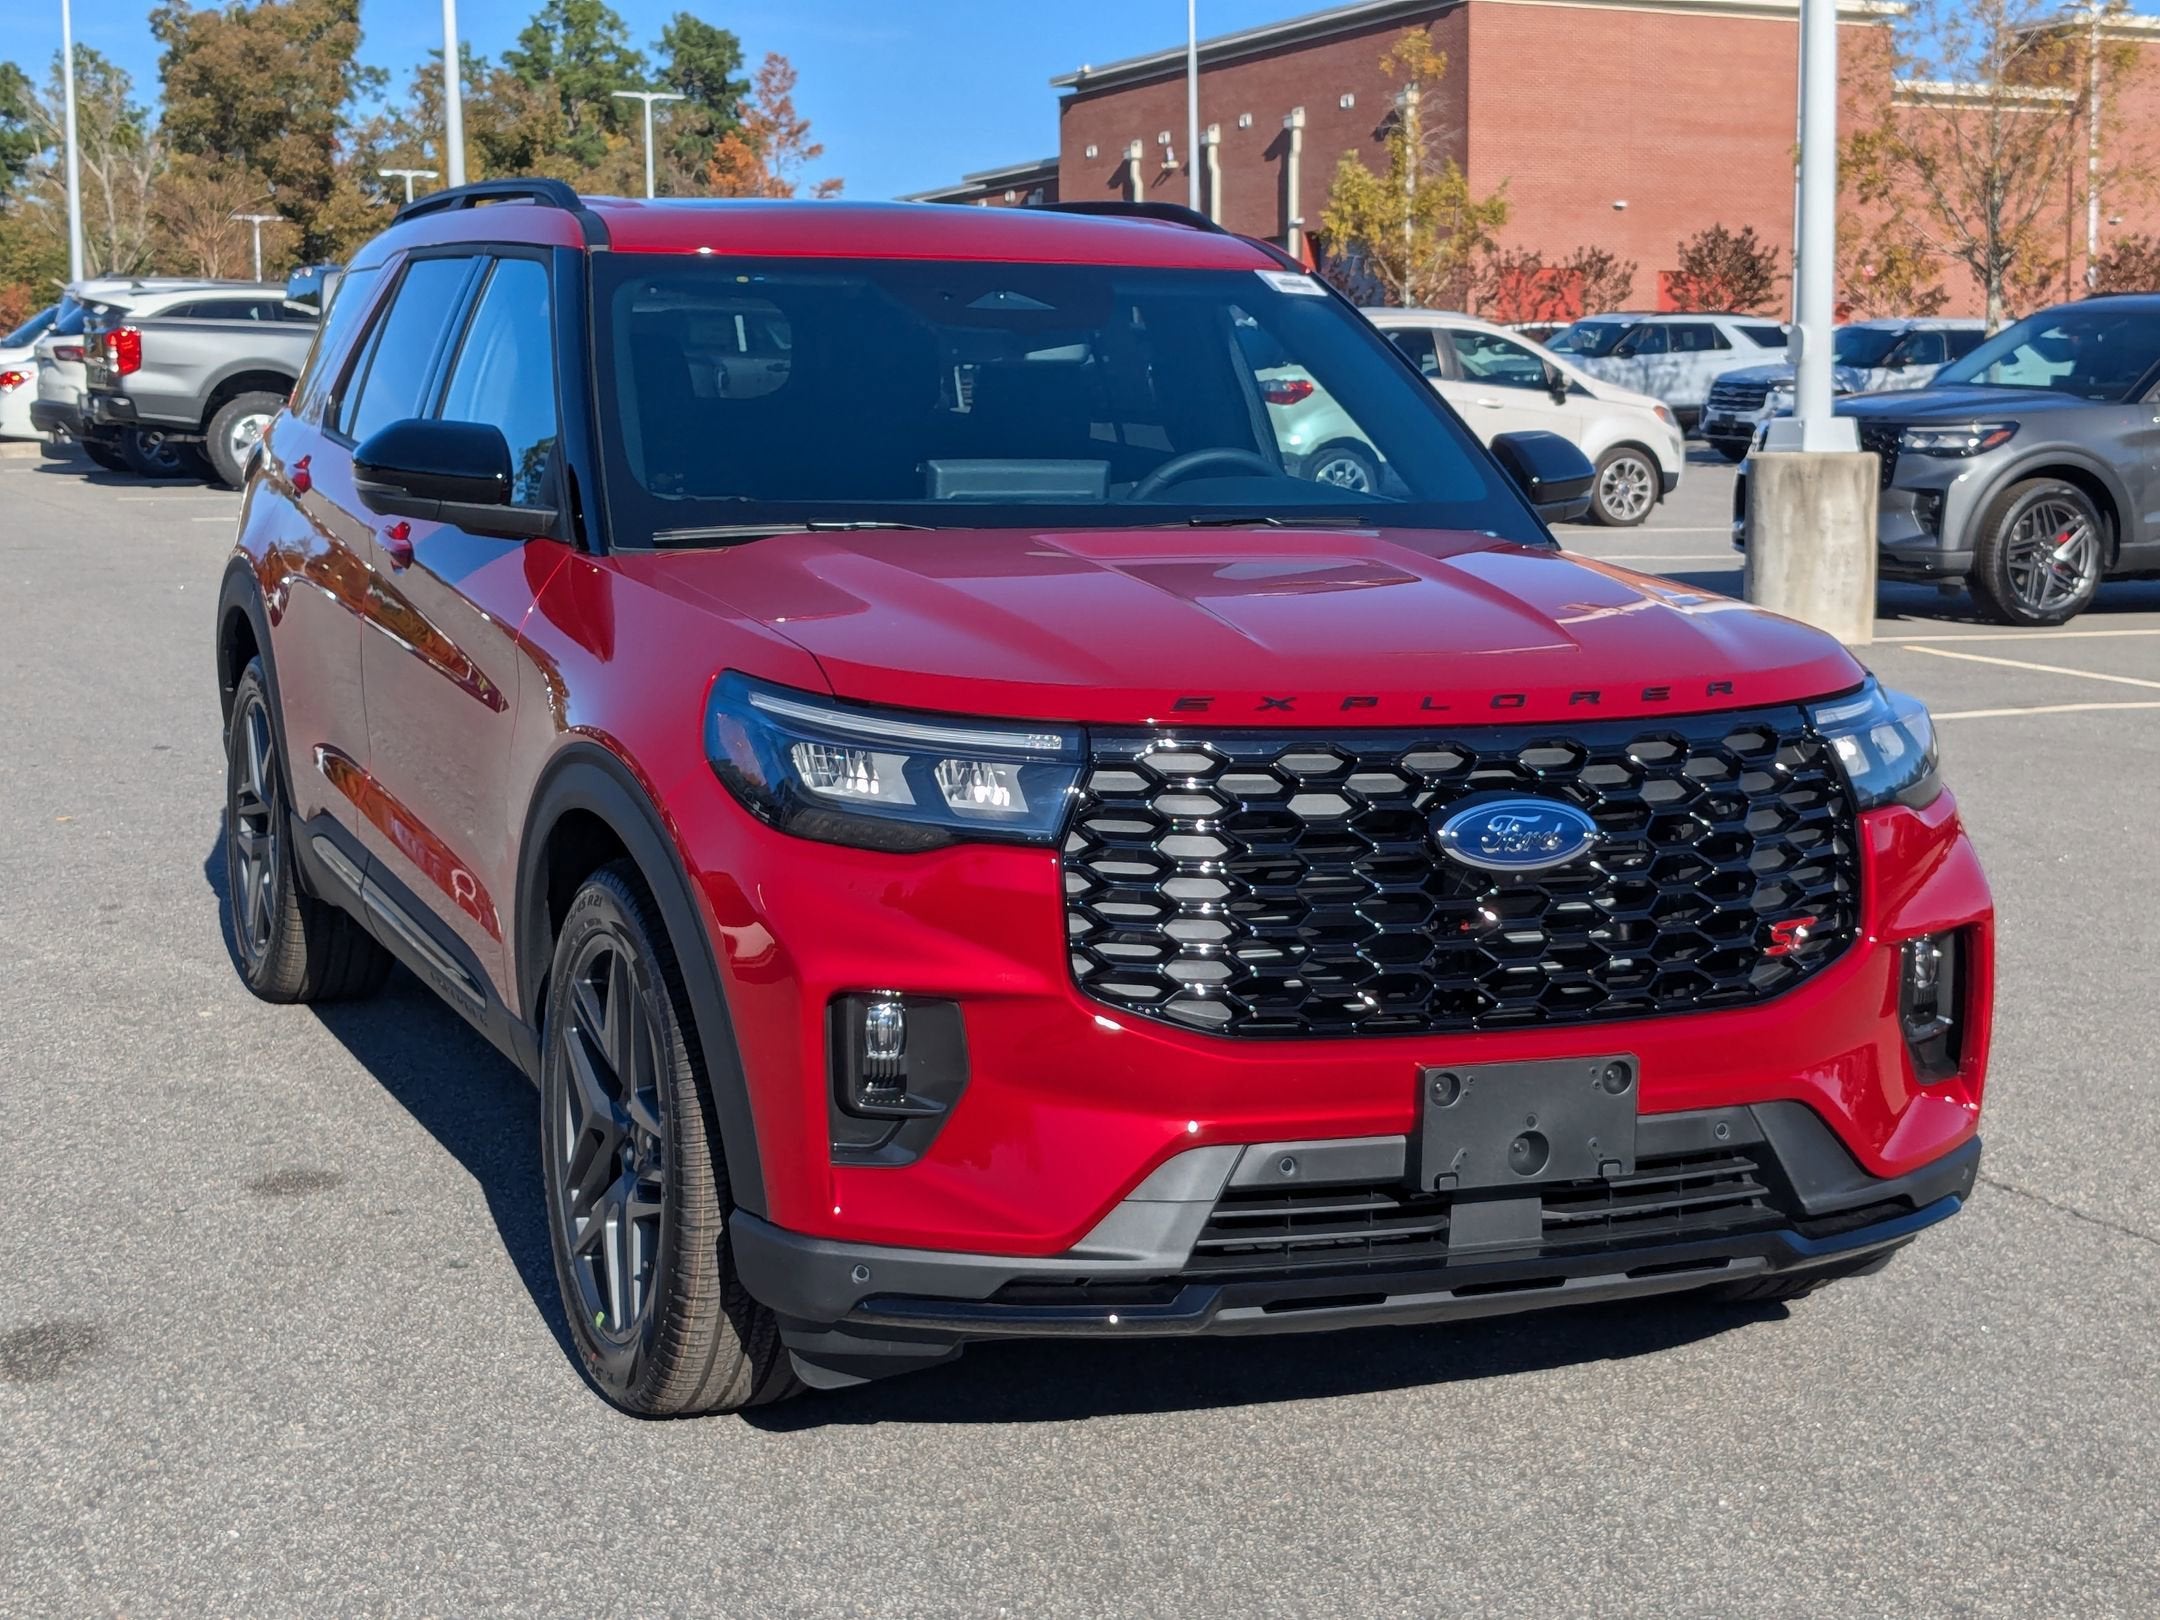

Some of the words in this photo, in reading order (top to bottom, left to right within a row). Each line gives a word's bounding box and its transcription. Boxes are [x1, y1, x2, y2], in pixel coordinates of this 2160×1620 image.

[1170, 681, 1734, 712] EXPLORER
[1481, 815, 1562, 853] Ford
[1764, 916, 1818, 955] ST
